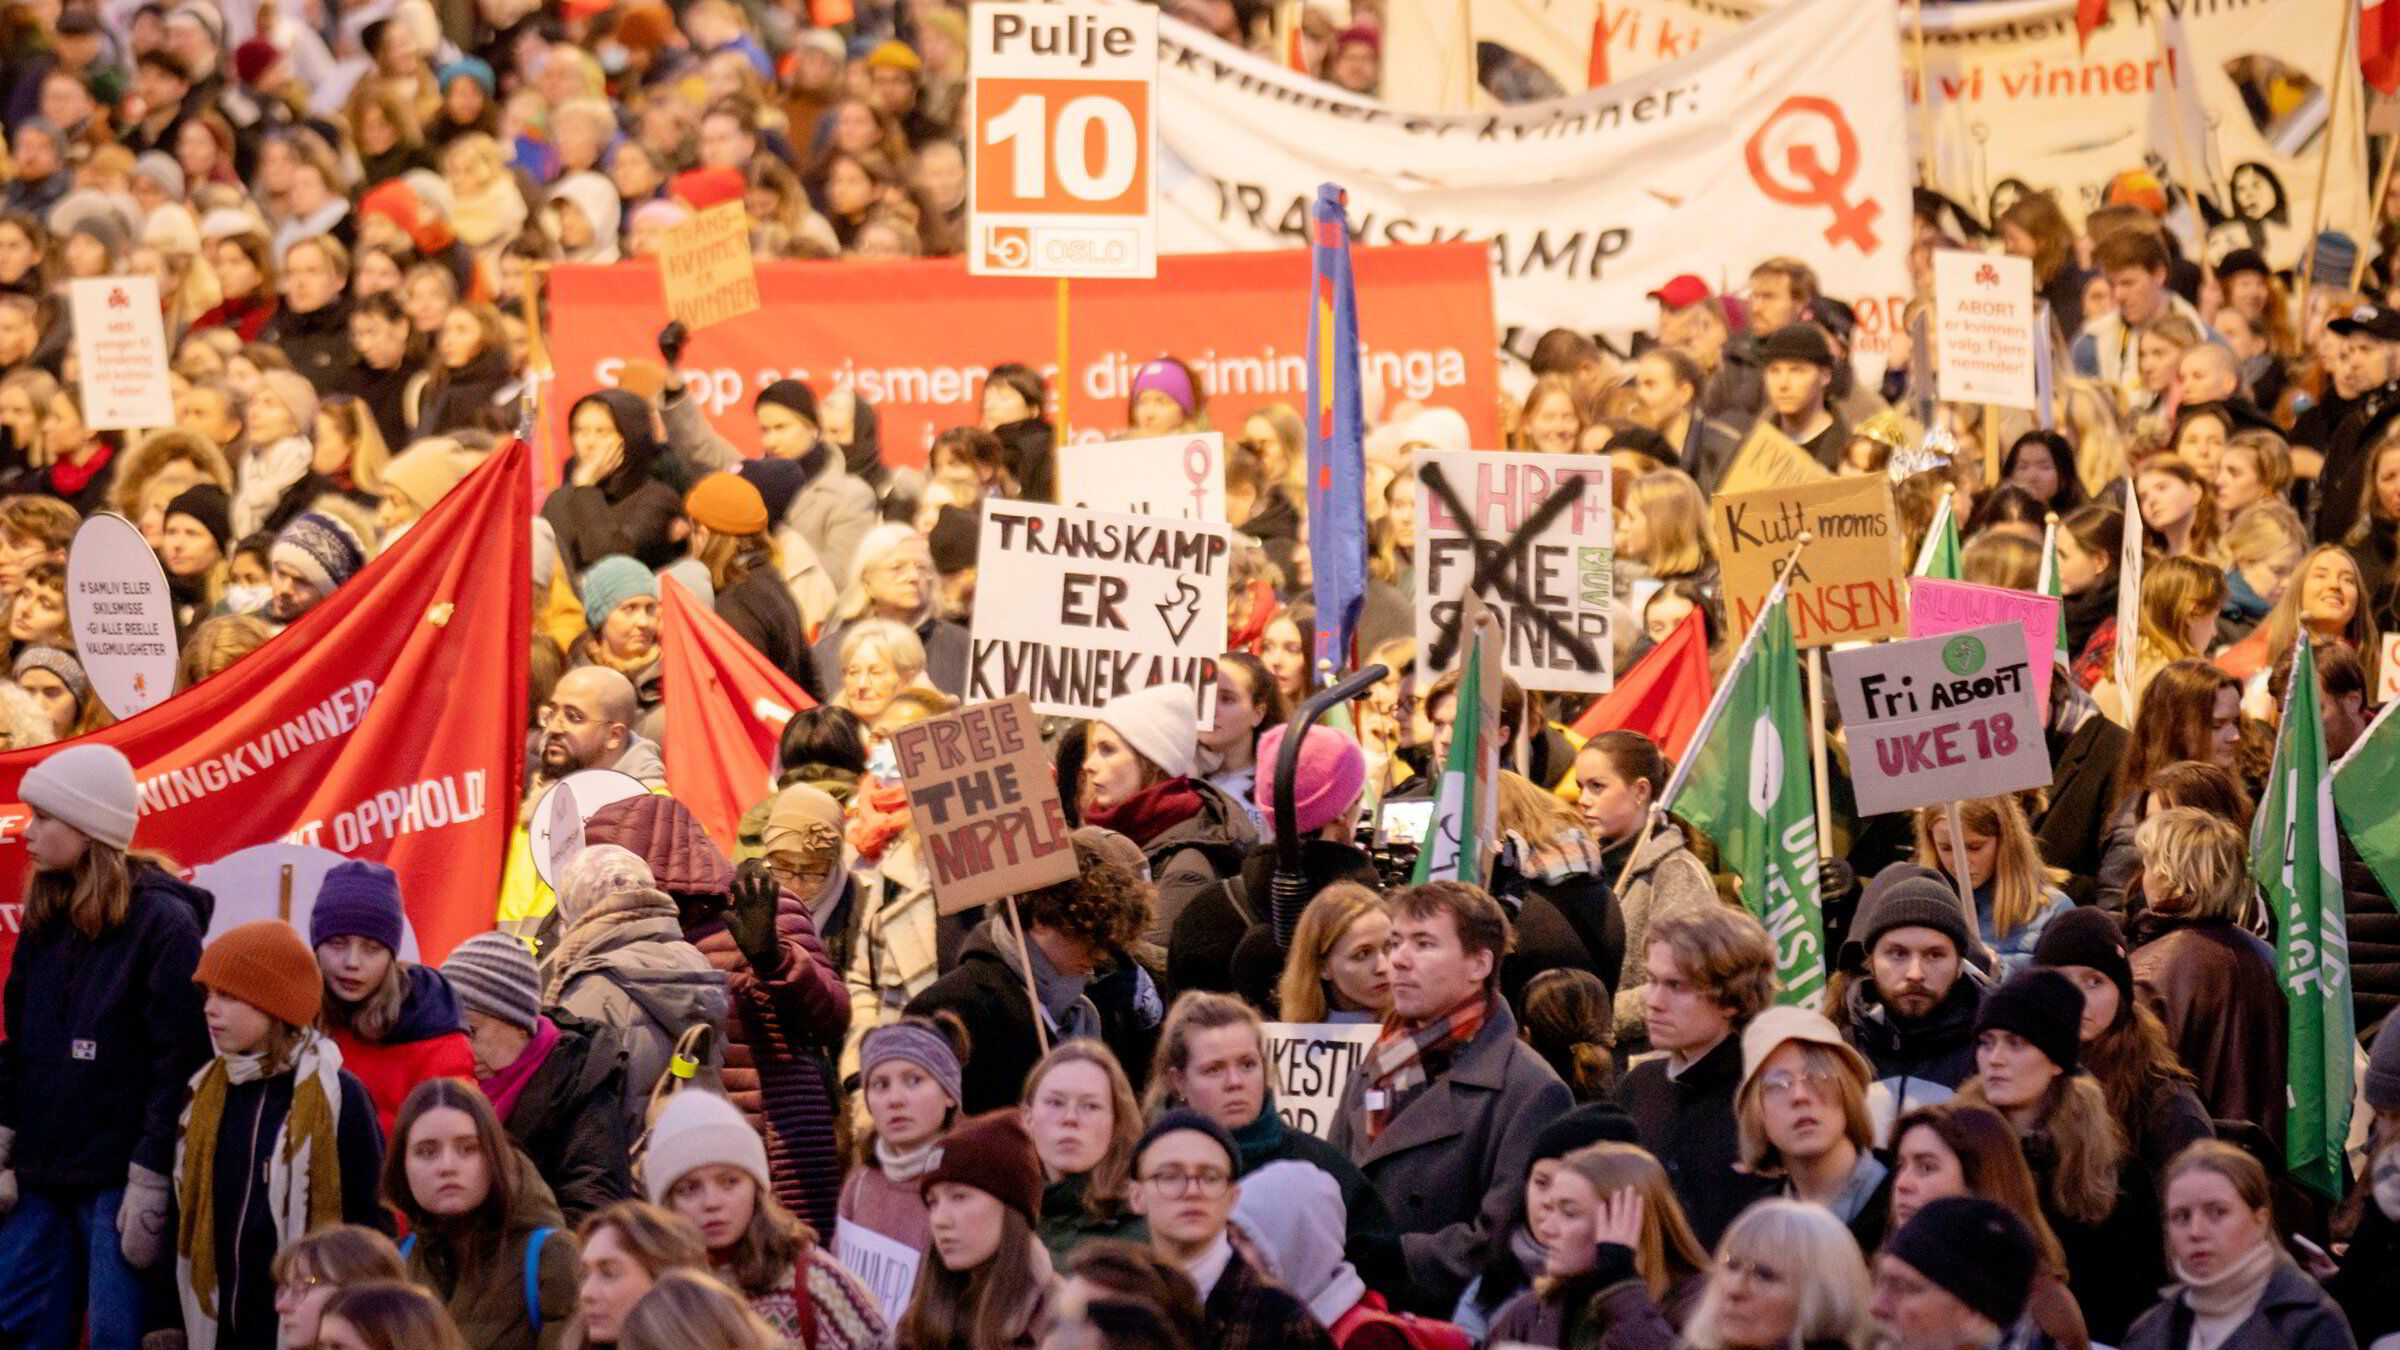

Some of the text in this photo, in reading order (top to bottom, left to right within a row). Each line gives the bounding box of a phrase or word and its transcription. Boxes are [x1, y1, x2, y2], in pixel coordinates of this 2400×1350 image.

[993, 14, 1136, 68] Pulje
[1941, 65, 1983, 102] vi
[987, 93, 1137, 202] 10
[1047, 240, 1127, 264] OSLO
[1958, 300, 2016, 318] ABORT
[595, 356, 744, 416] Spp
[990, 512, 1228, 576] TRANSKAMP
[1726, 501, 1889, 553] Kutt moms
[88, 581, 120, 595] SAMLIV
[122, 582, 151, 595] ELLER
[92, 602, 145, 616] SKILSMISSE
[1060, 572, 1130, 632] ER
[1735, 577, 1901, 642] MNSEN
[85, 642, 167, 656] VALGMULIGHETER
[101, 622, 123, 636] ALLE
[124, 622, 159, 636] REELLE
[1860, 673, 1918, 720] Fri
[136, 679, 376, 816] NINGKVINNER
[896, 703, 1025, 779] FREE
[1876, 712, 2018, 777] UKE 18
[334, 768, 486, 853] OPPHOLD!
[911, 763, 1022, 825] THE
[929, 798, 1069, 886] NIPPLE
